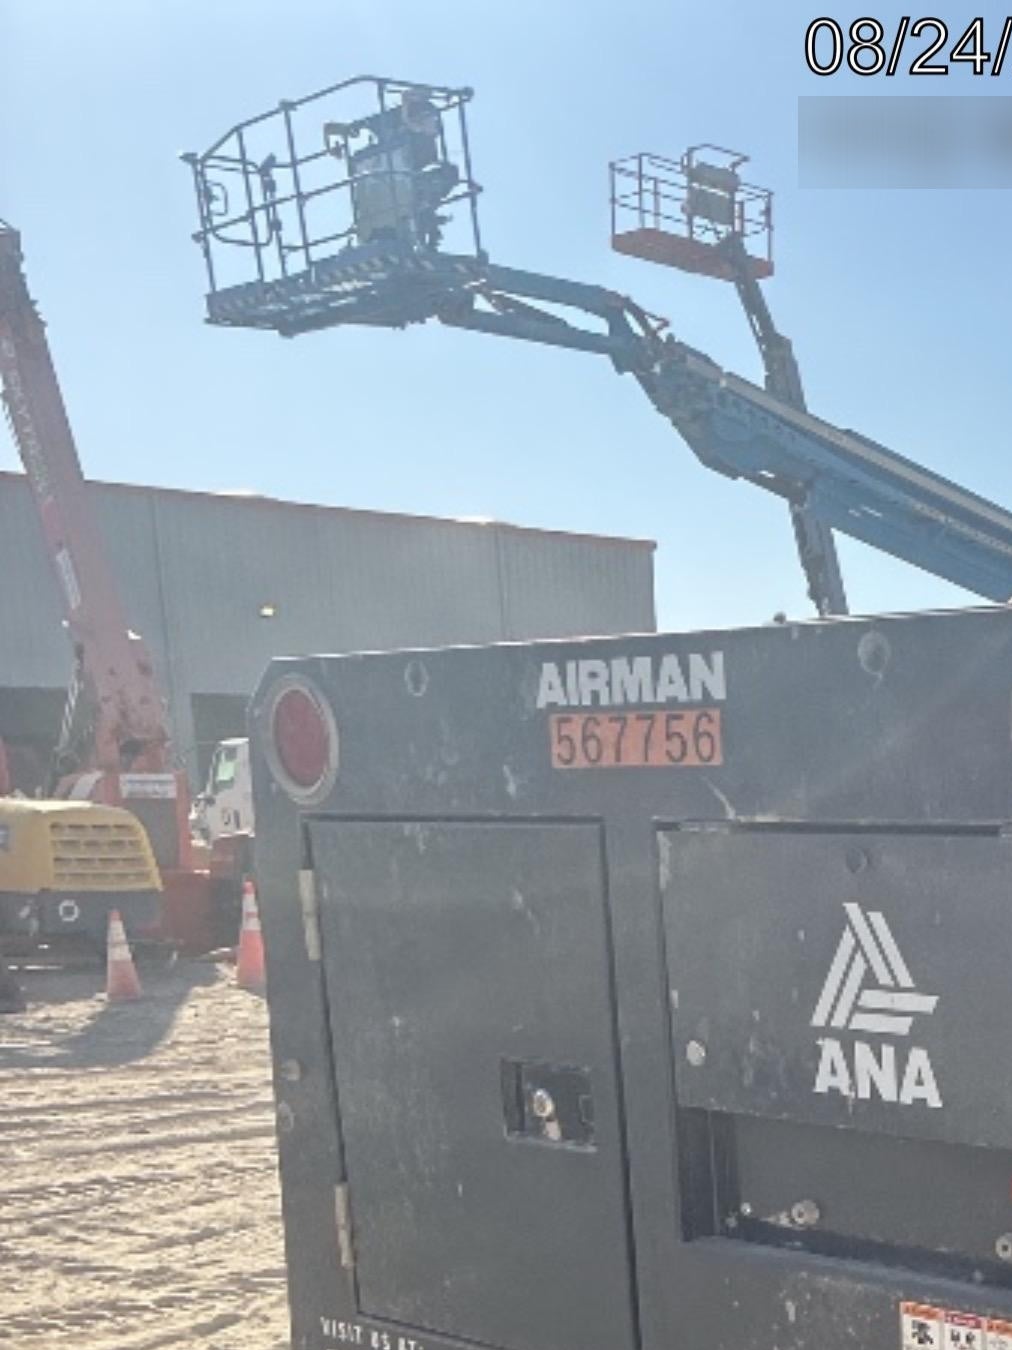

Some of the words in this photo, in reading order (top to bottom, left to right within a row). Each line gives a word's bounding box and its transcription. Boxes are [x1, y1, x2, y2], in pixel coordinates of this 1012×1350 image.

[536, 651, 726, 709] AIRMAN
[555, 710, 717, 766] 567756
[813, 1037, 943, 1108] ANA
[320, 1316, 363, 1344] VISIT
